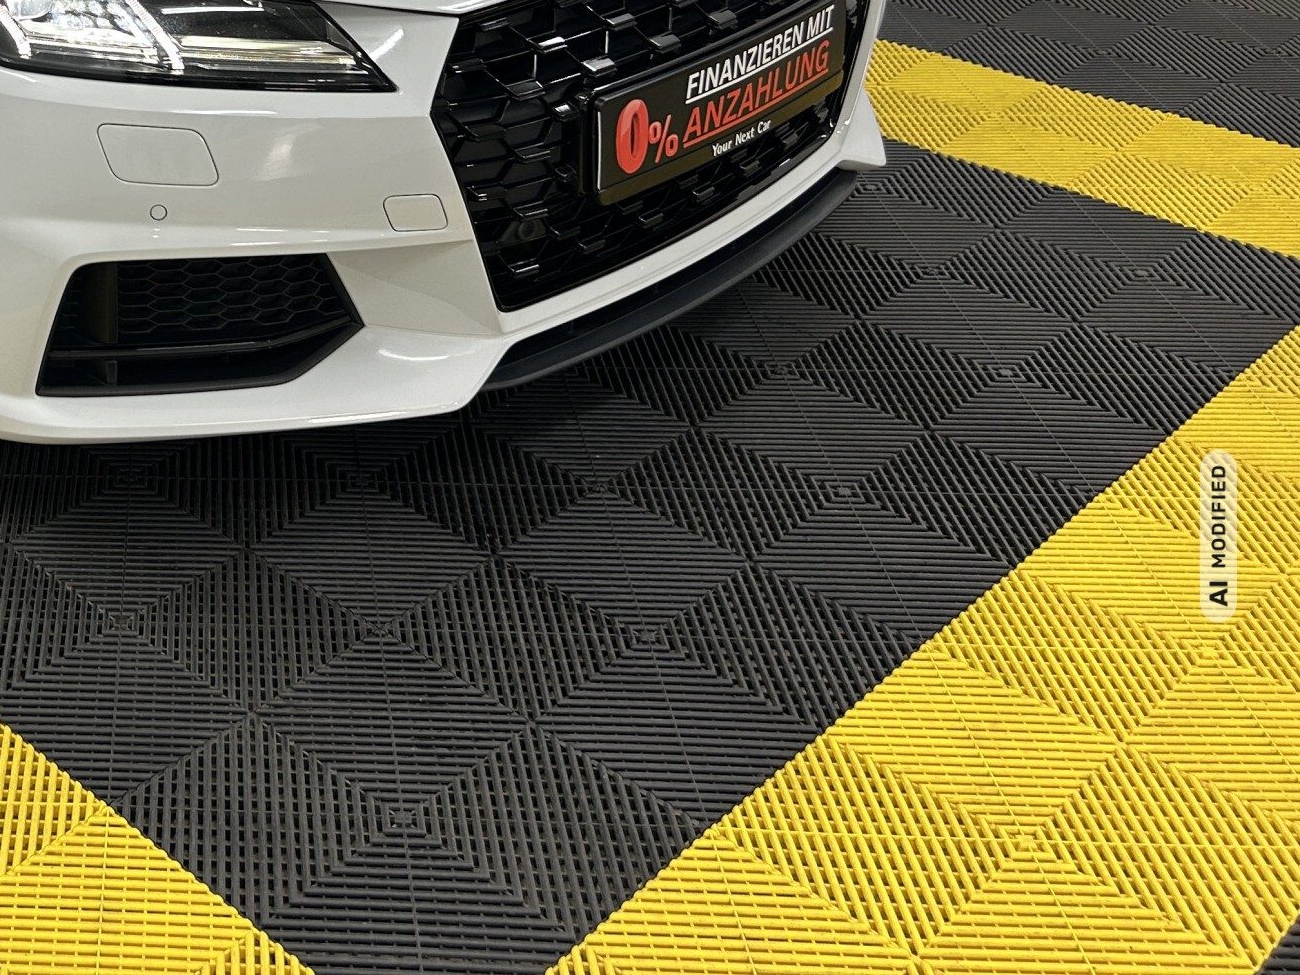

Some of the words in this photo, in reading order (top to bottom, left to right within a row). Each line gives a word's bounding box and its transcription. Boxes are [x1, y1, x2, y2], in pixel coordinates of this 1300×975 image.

[685, 21, 805, 100] FINANZIEREN
[805, 4, 835, 38] MIT
[615, 98, 679, 174] 0%
[683, 39, 831, 143] ANZAHLUNG
[711, 139, 733, 157] Your
[734, 126, 756, 146] Next
[757, 119, 772, 134] Car
